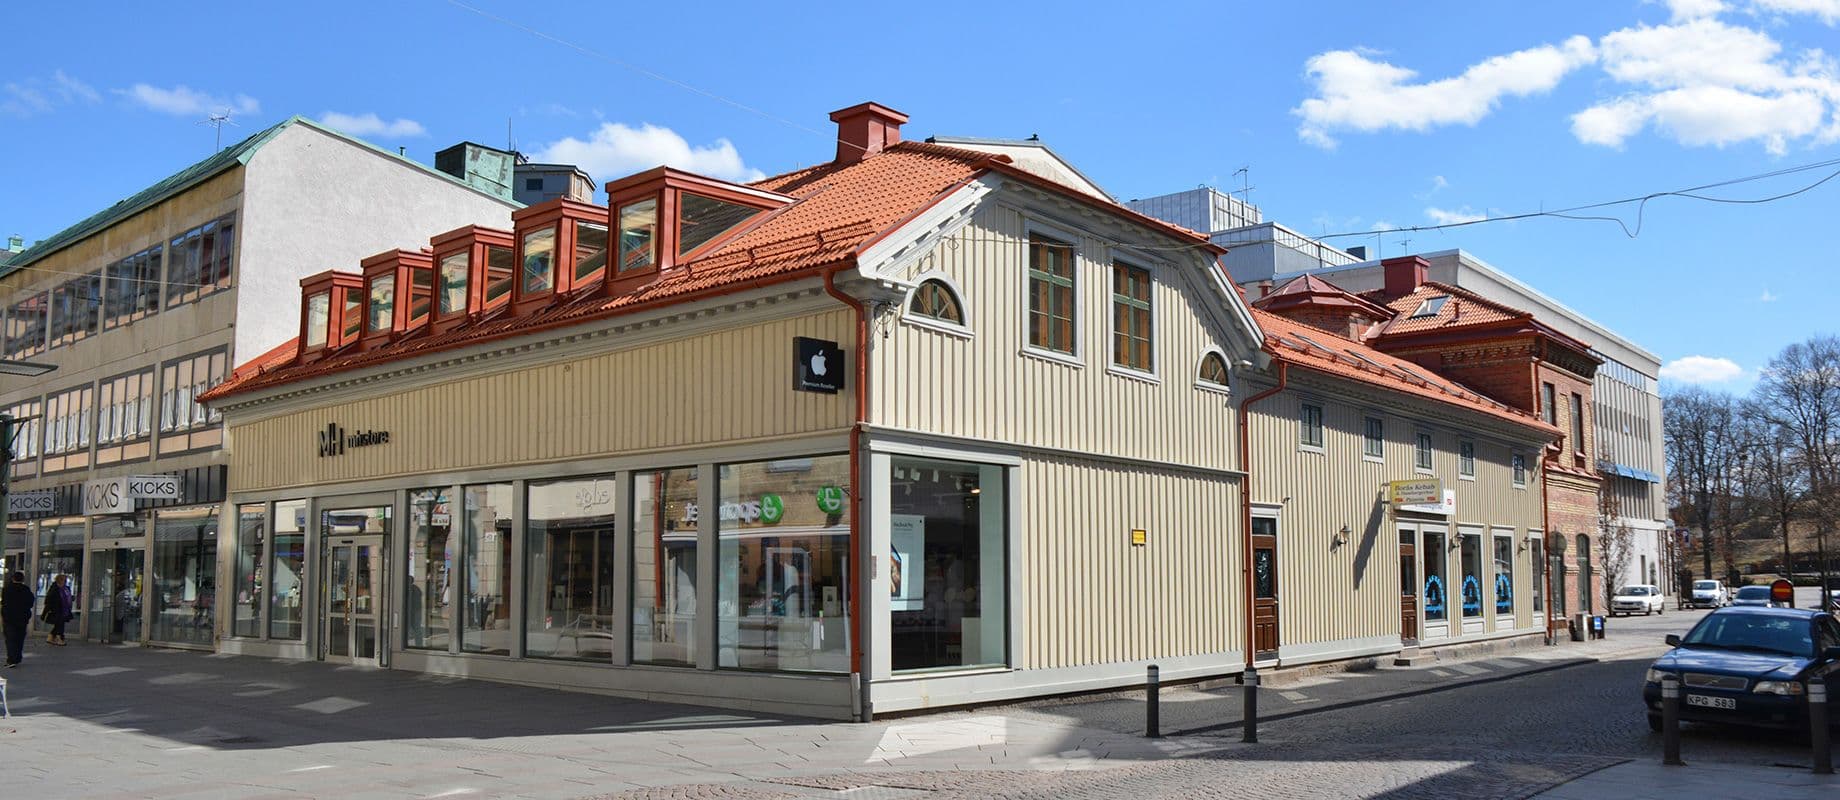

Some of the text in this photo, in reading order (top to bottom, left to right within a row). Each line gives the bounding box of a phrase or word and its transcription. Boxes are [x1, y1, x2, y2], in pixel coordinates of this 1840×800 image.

[129, 482, 175, 495] KICKS
[86, 482, 119, 510] KICKS
[10, 497, 51, 510] KICKS
[1689, 695, 1709, 706] KPG
